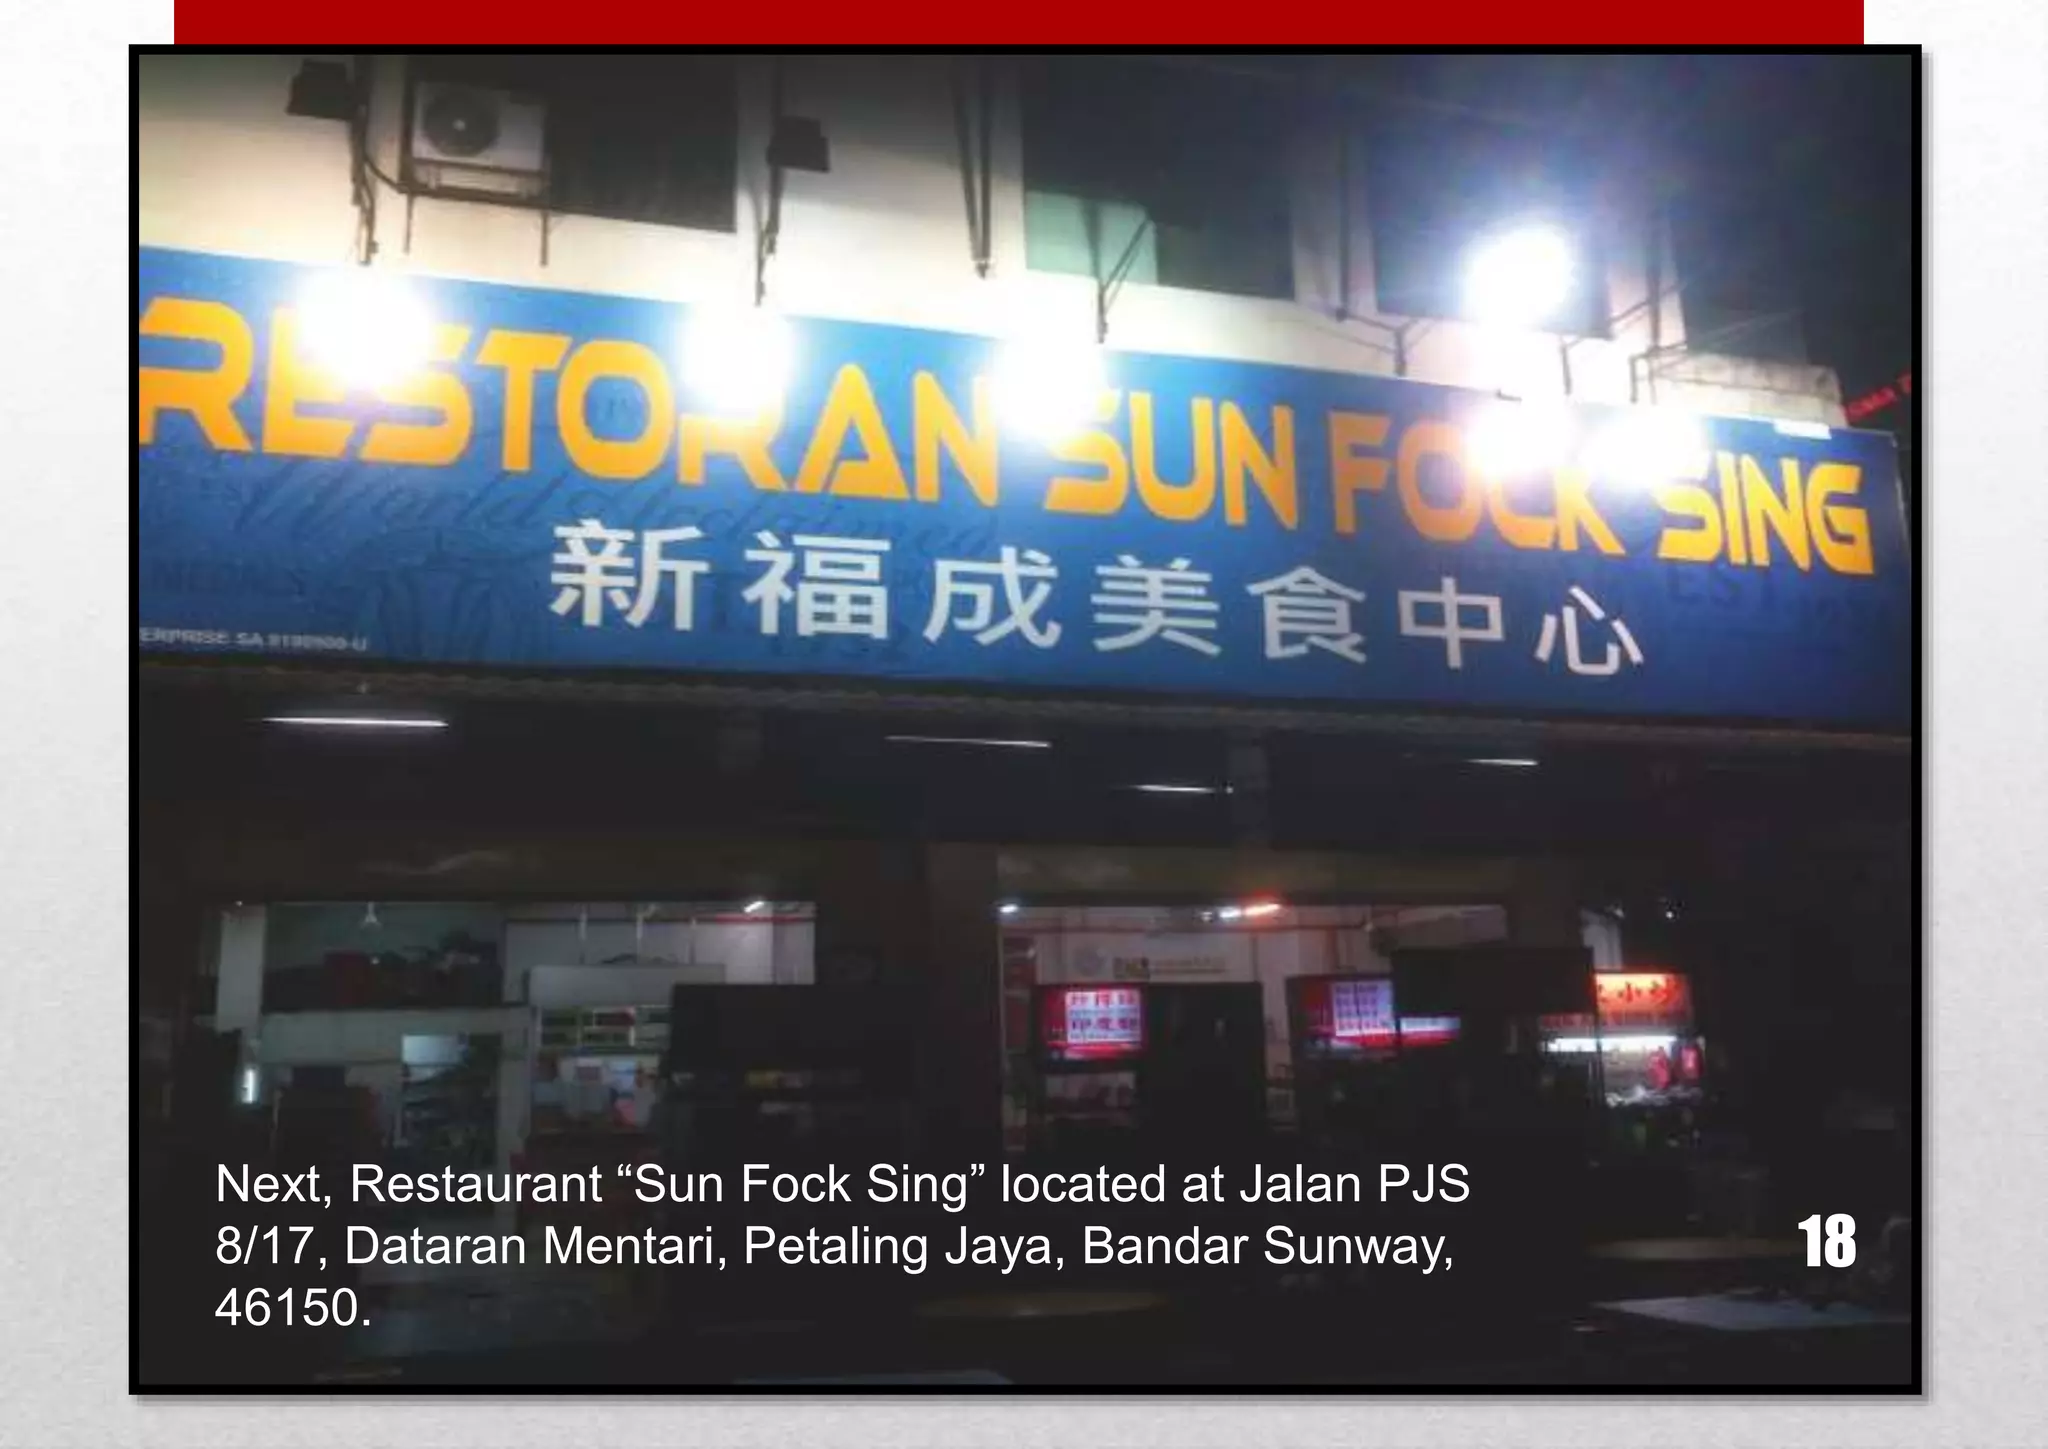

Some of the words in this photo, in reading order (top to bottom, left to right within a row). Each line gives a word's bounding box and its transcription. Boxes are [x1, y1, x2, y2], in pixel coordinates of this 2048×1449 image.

[138, 297, 999, 507] RESTORAN
[1045, 384, 1299, 528] SUN
[1327, 409, 1626, 558] FOCK
[1656, 451, 1875, 575] SING
[549, 516, 1645, 676] 新福成美食中心
